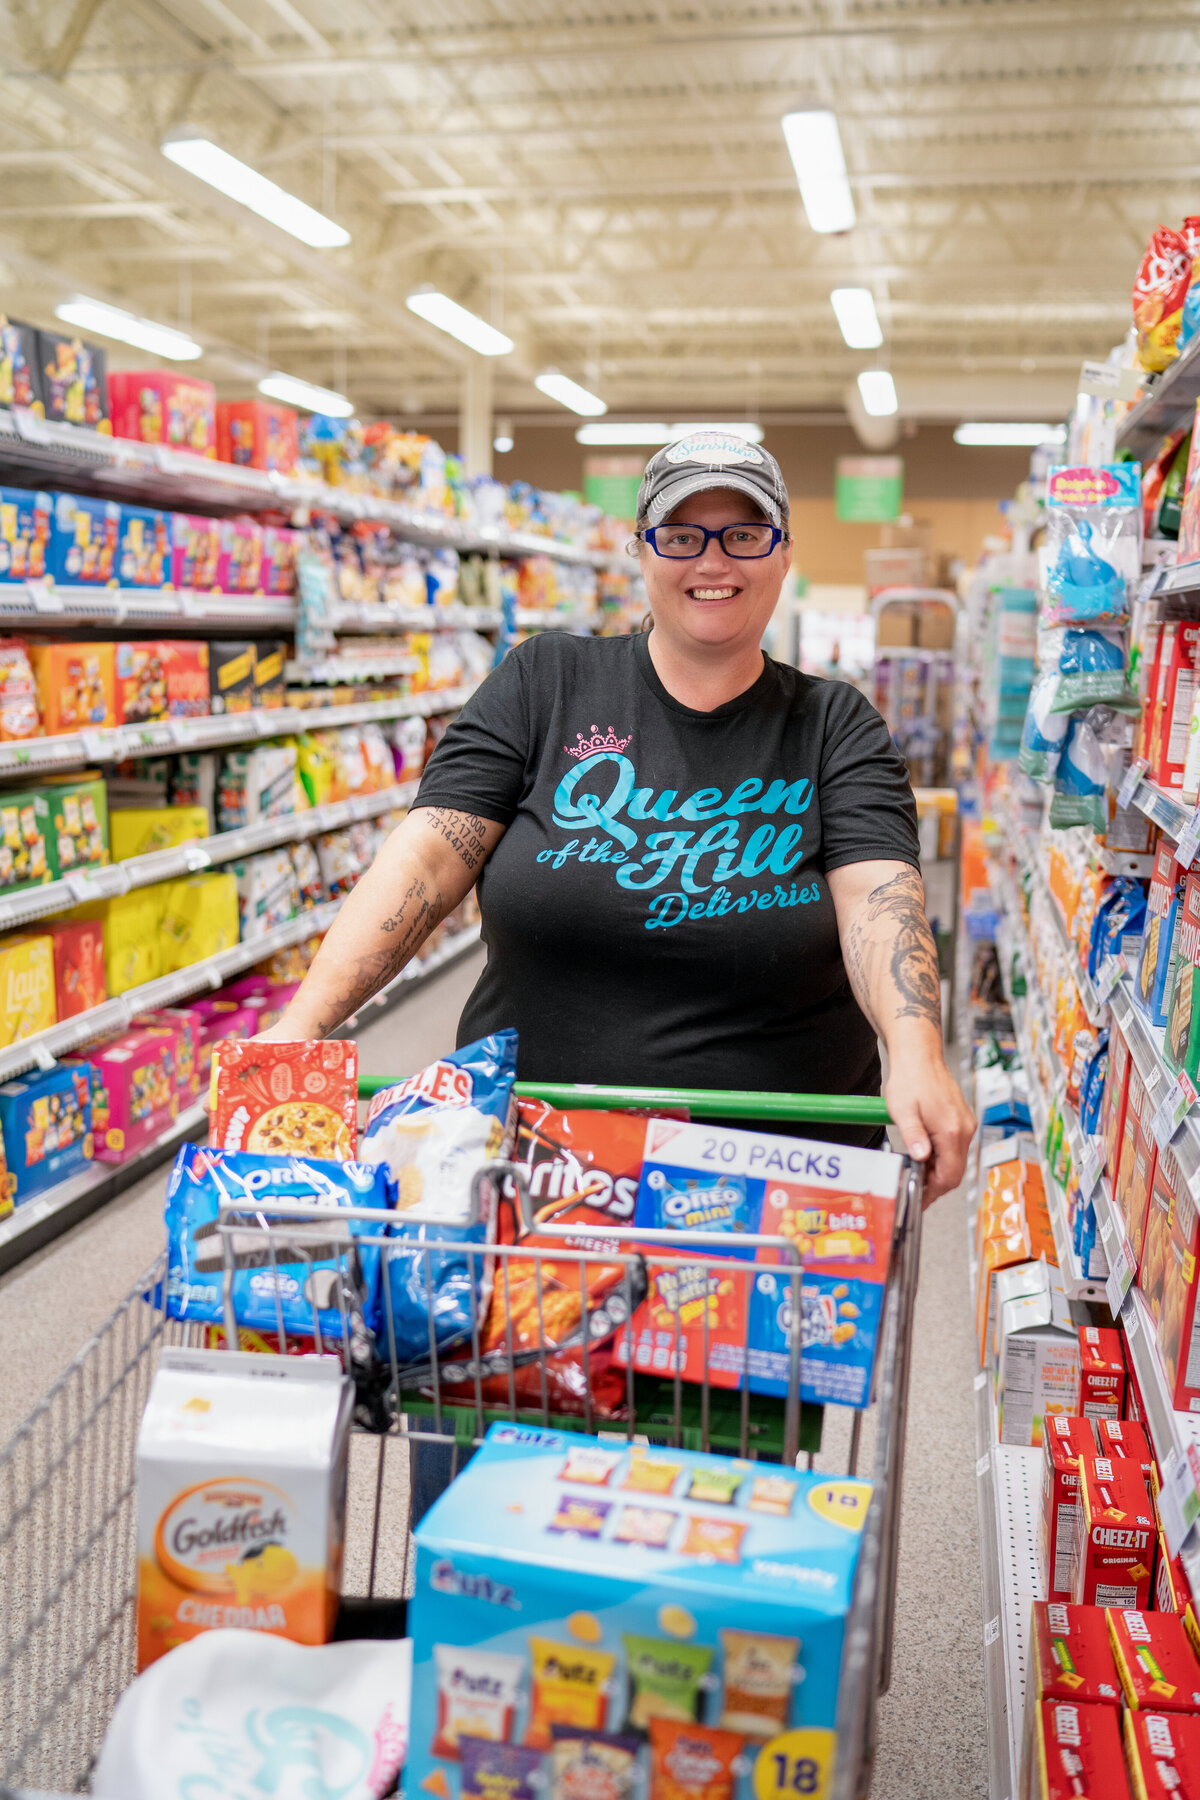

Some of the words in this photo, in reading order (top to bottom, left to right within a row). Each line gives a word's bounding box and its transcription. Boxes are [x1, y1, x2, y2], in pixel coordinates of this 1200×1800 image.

[552, 751, 814, 852] Queen
[536, 838, 580, 869] of
[577, 837, 630, 864] the
[615, 819, 804, 894] Hill
[644, 883, 820, 930] Deliveries
[701, 1137, 737, 1163] 20
[748, 1145, 842, 1179] PACKS
[664, 1187, 740, 1218] OREO
[685, 1203, 732, 1227] mini
[173, 1509, 286, 1555] Goldfish
[1091, 1526, 1150, 1549] CHEEZ-IT
[1102, 1556, 1139, 1565] ORIGINAL
[175, 1600, 287, 1628] CHEDDAR
[773, 1752, 820, 1795] 18
